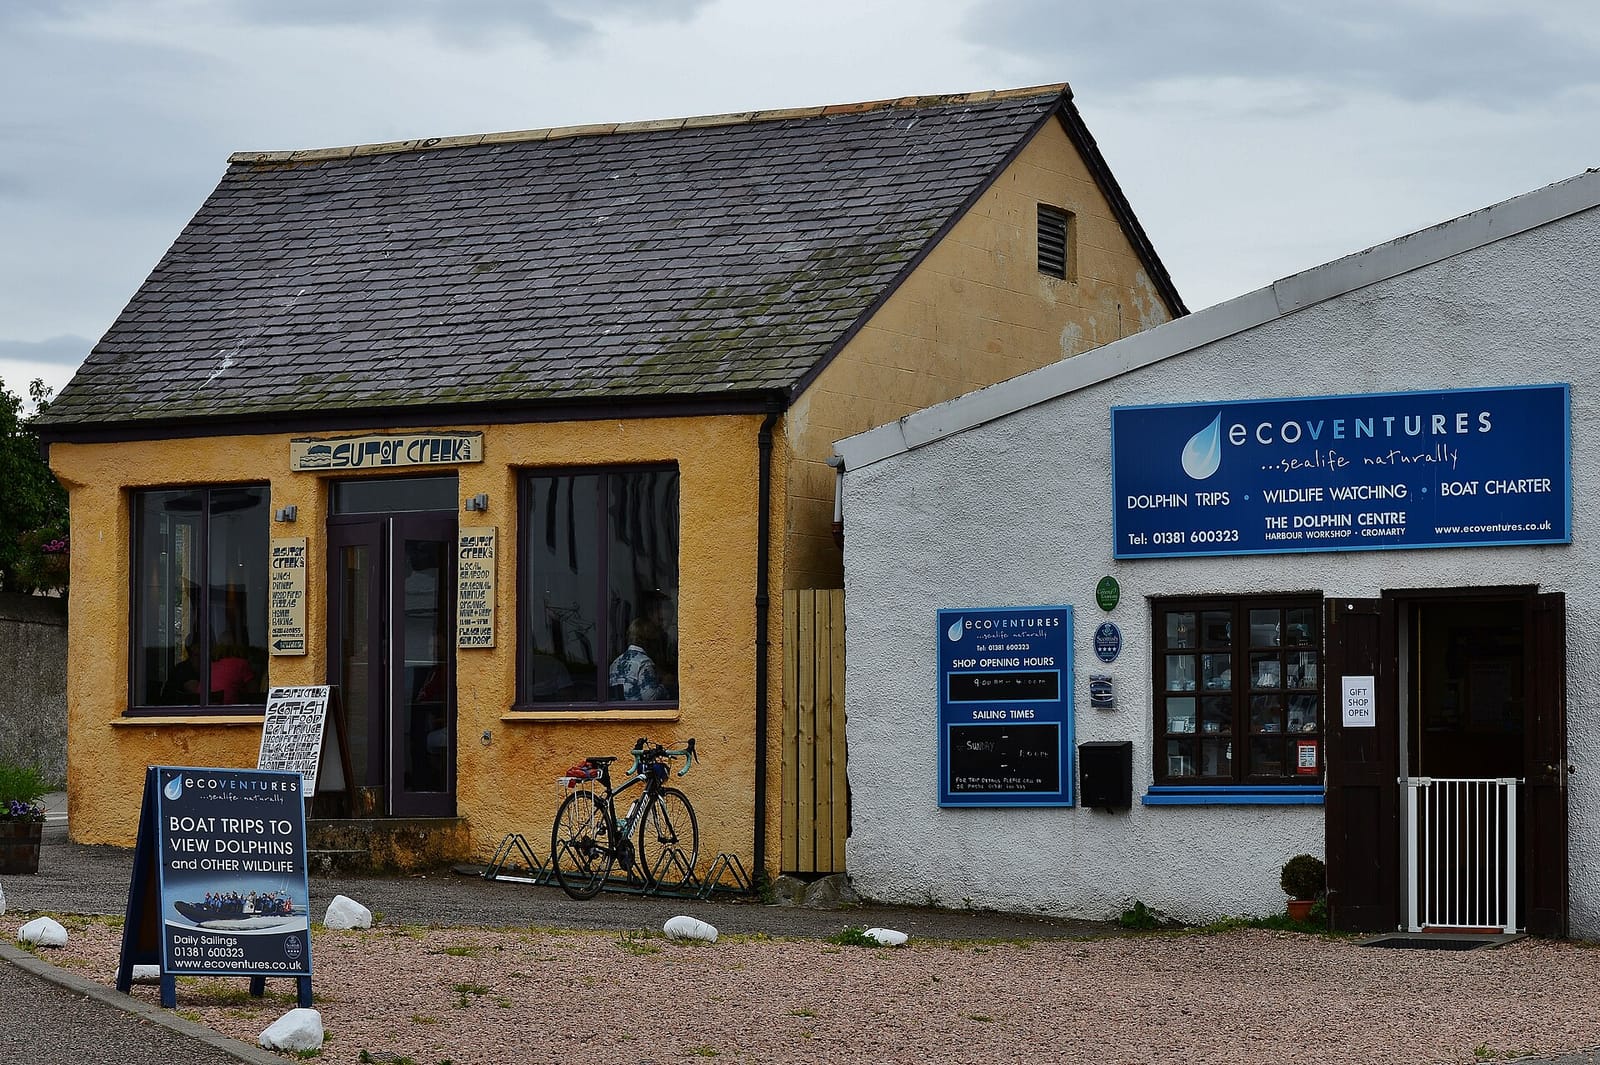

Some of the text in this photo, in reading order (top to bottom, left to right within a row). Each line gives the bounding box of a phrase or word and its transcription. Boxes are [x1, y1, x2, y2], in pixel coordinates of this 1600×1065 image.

[1364, 444, 1458, 470] naturally
[1263, 484, 1407, 504] WILDLIFE WATCHING
[1441, 479, 1551, 496] BOAT CHARTER
[1127, 492, 1230, 510] DOLPHIN TRIPS
[1265, 512, 1406, 529] THE DOLPHIN CENTRE
[1435, 520, 1551, 534] www.ecoventures.co.uk
[1128, 530, 1239, 545] Tel: 01381 600323
[1265, 527, 1406, 541] HARBOUR WORKSHOP CROMARTY
[1013, 630, 1047, 639] naturally
[953, 657, 1054, 668] SHOP OPENING HOURS
[973, 710, 1034, 719] SAILING TIMES
[244, 794, 284, 804] naturally
[170, 817, 292, 834] BOAT TRIPS TO
[170, 838, 293, 854] VIEW DOLPHINS
[172, 859, 293, 872] and OTHER WILDLIFE
[174, 936, 237, 946] Daily Sailings
[174, 947, 244, 957] 01381 600323
[175, 960, 302, 970] www.ecoventures.co.uk
